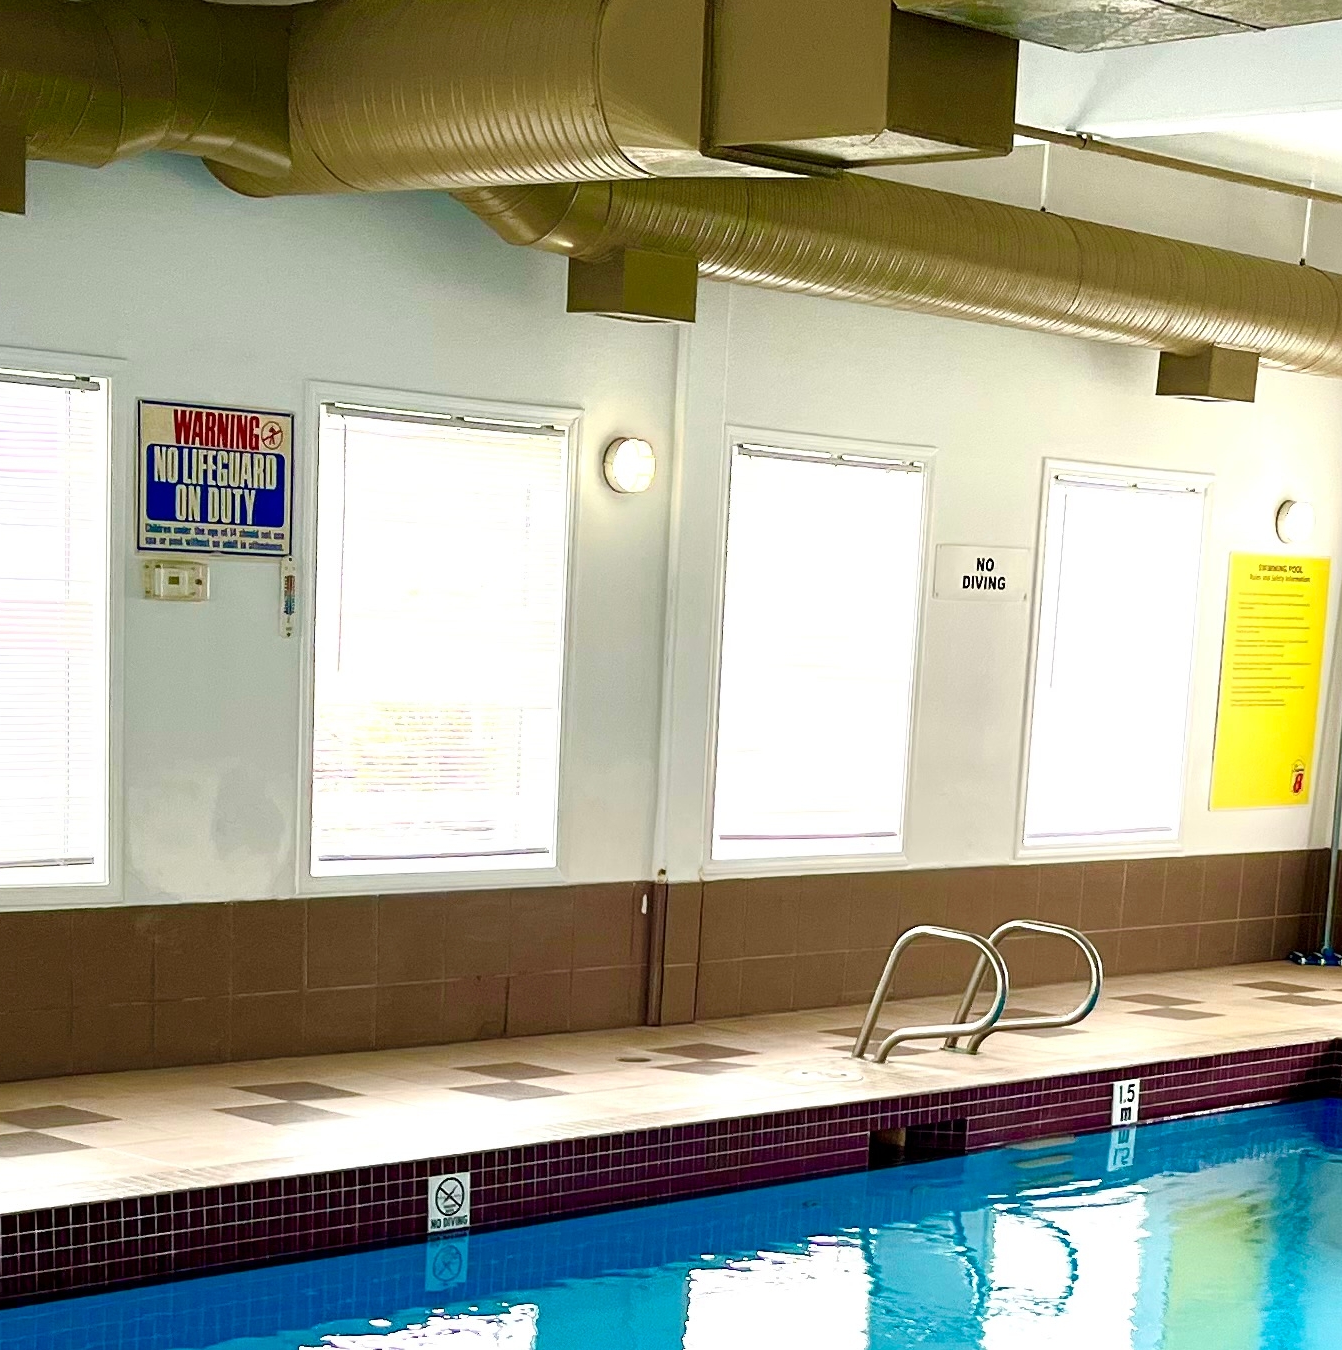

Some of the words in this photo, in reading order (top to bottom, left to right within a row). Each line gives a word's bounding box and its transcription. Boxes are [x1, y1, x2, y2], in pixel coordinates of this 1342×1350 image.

[173, 409, 260, 451] WARNING
[153, 446, 178, 483] NO
[182, 448, 277, 490] LIFEGUARD
[175, 484, 201, 522] ON
[207, 486, 256, 525] DUTY
[976, 557, 995, 572] NO
[962, 575, 1006, 590] DIVING
[1119, 1083, 1136, 1104] 1.5
[1120, 1107, 1132, 1122] m
